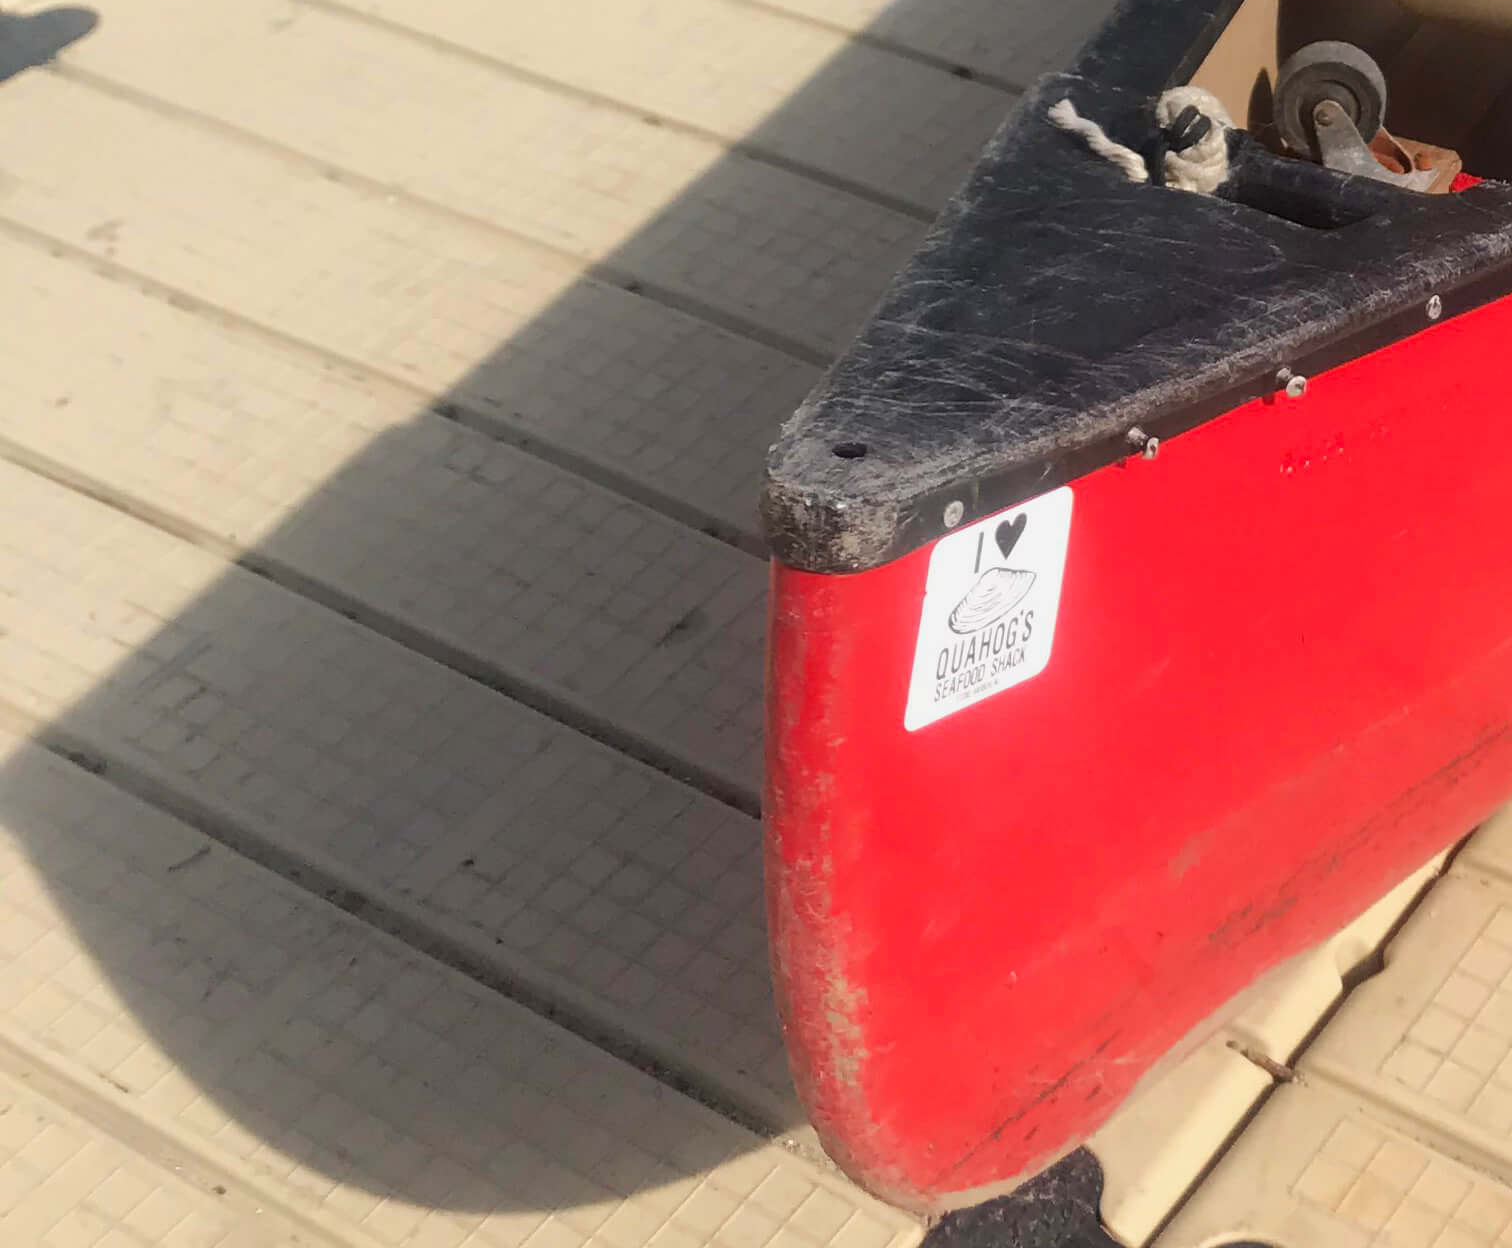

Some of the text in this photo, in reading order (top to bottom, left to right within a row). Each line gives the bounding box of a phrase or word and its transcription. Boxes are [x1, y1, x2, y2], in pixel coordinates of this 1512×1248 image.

[973, 531, 985, 574] I
[935, 609, 1035, 681] QUAHOG'S
[933, 663, 986, 702] SEAFOOD
[990, 648, 1026, 678] SHACK
